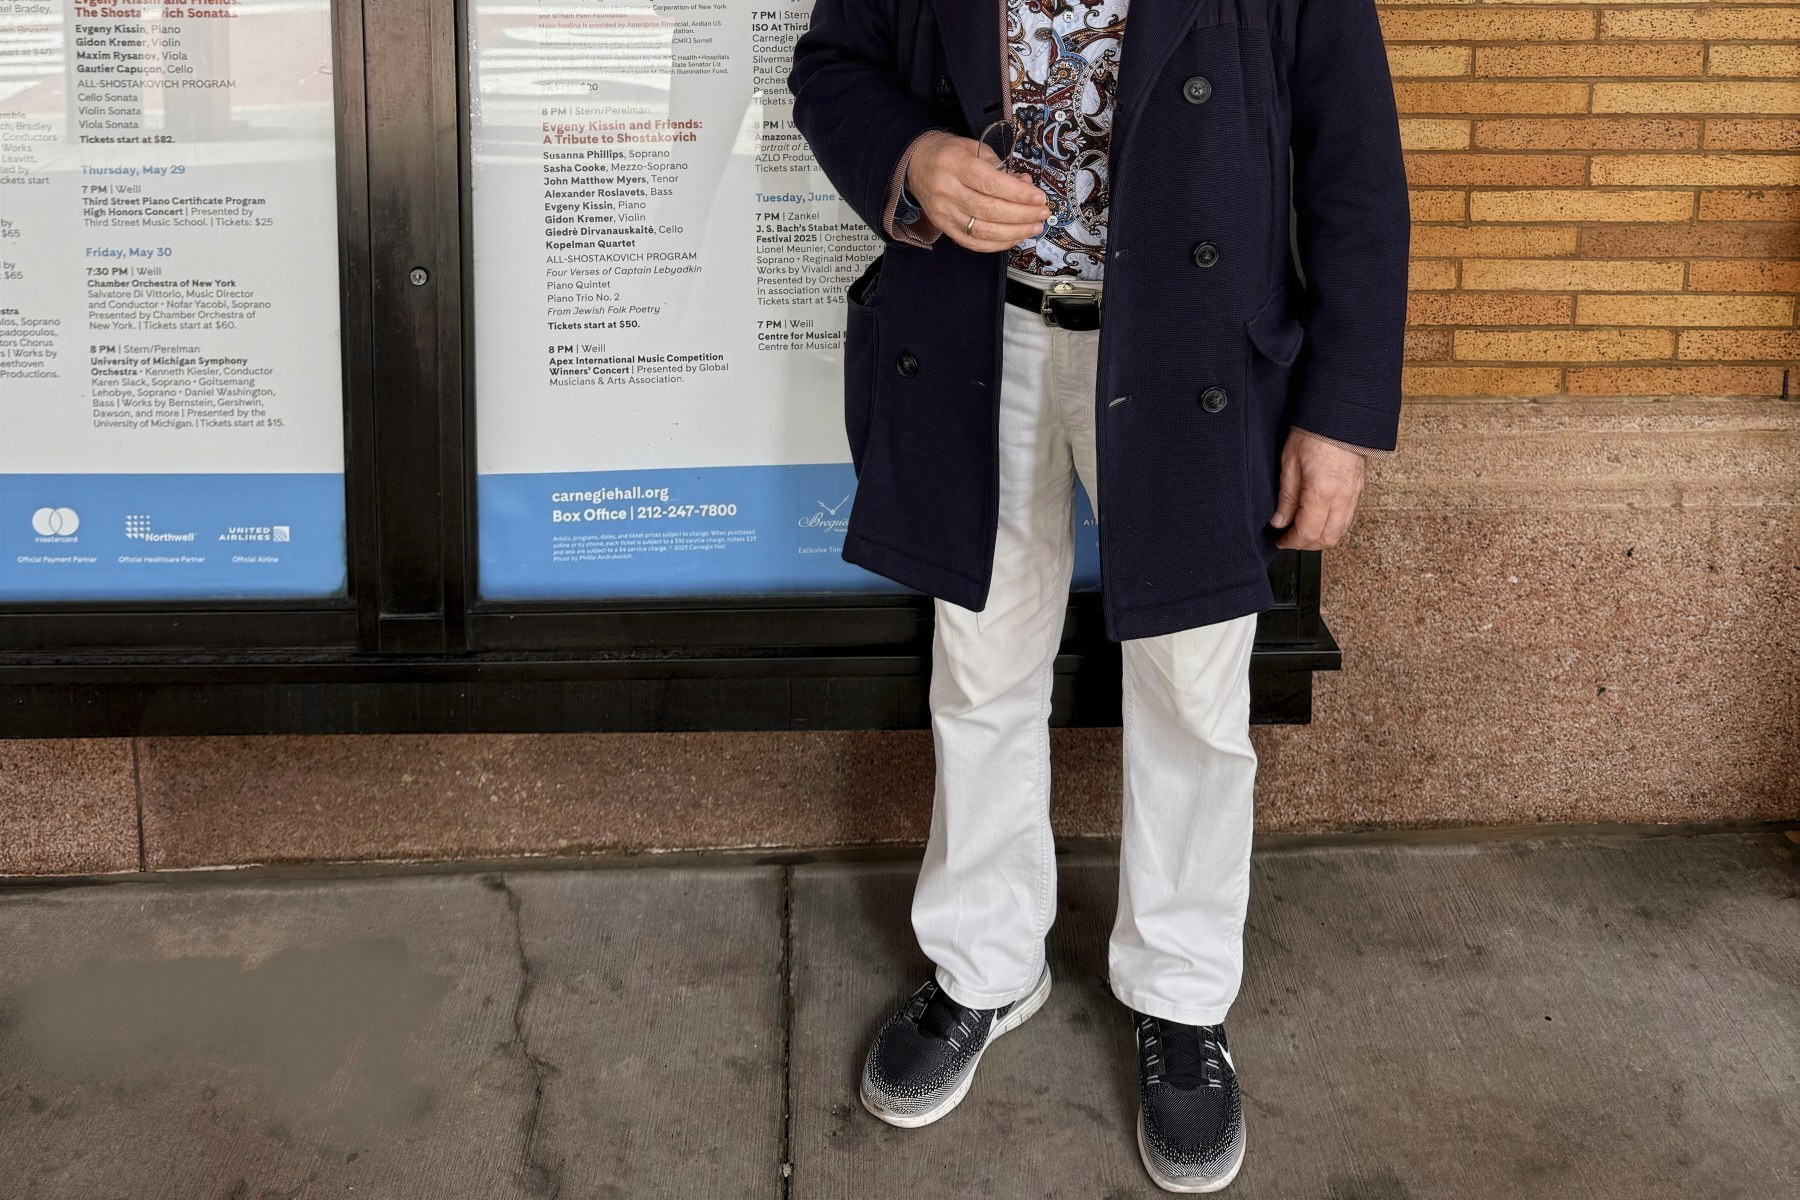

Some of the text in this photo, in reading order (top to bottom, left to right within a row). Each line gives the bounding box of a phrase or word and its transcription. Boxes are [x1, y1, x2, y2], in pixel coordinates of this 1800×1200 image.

[76, 37, 180, 47] Gidon Kremer, Violin
[76, 50, 187, 62] Maxim Rysanov, Viola
[543, 131, 696, 144] A Tribute to Shostakovich
[543, 149, 669, 160] Susanna Phillips, Soprano
[80, 165, 185, 176] Thursday, May 29
[543, 162, 688, 173] Sasha Cooke, Mezzo-Soprano
[543, 174, 678, 185] John Matthew Myers, Tenor
[544, 187, 672, 198] Alexander Roslavets, Bass
[755, 192, 835, 204] Tuesday, June
[82, 196, 265, 206] Third Street Piano Certificate Program
[755, 212, 819, 221] 7 PM Zankel
[546, 239, 635, 250] Kopelman Quartet
[86, 247, 172, 259] Friday, May 30
[546, 268, 567, 276] Four
[602, 266, 612, 275] of
[614, 266, 651, 276] Captain
[653, 265, 702, 275] Lebyadkin
[87, 279, 236, 287] Chamber Orchestra of New York
[547, 321, 581, 330] Tickets
[584, 321, 605, 329] start
[619, 320, 639, 328] $50.
[91, 356, 248, 367] University of Michigan Symphony
[549, 353, 723, 366] Apex International Music Competition
[552, 486, 668, 503] carnegiehall.org
[553, 504, 736, 522] Box Office 212-247-7800
[145, 533, 194, 541] Northwell
